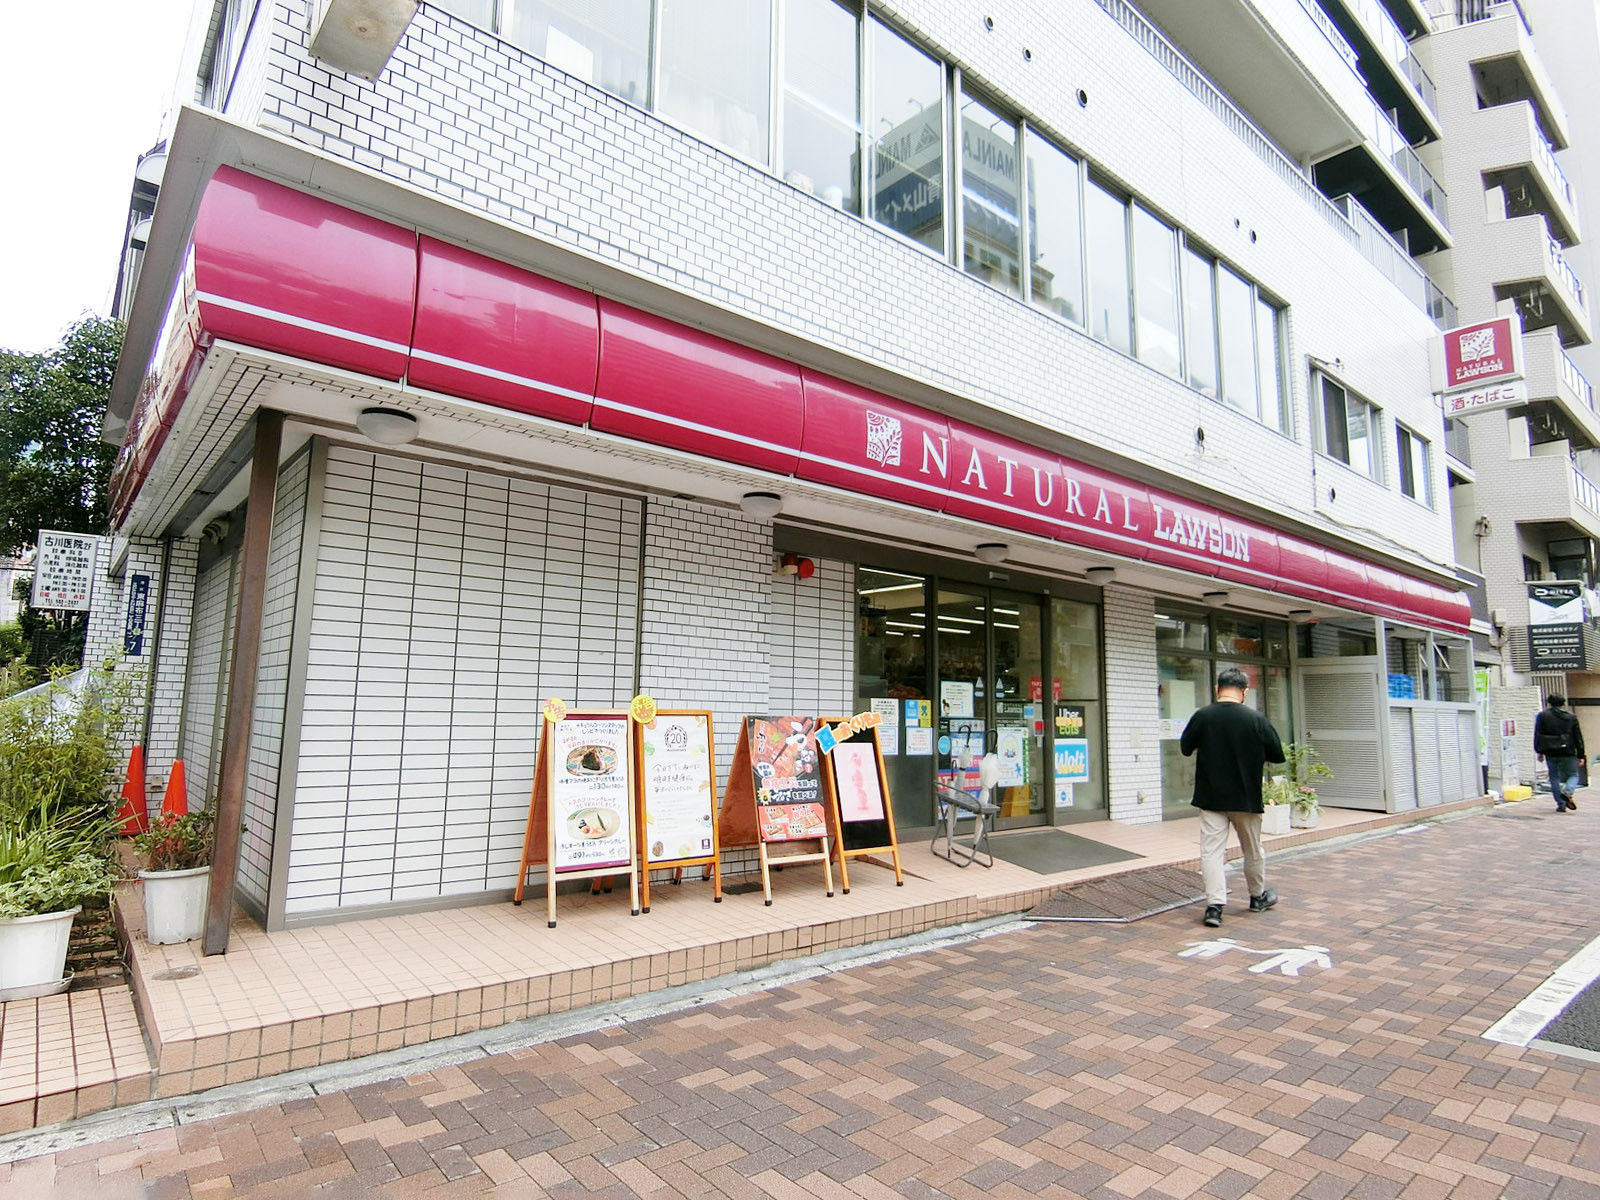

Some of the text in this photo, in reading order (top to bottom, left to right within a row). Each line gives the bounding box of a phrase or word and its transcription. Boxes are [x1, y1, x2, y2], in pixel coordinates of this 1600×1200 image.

[1456, 358, 1502, 373] NATURAL
[1456, 363, 1503, 380] LAWSON
[920, 431, 1250, 562] NATURAL LAWSON
[45, 536, 83, 549] 古川医院
[1058, 708, 1079, 718] Uber
[670, 733, 682, 744] 20
[1055, 750, 1086, 769] Wolt
